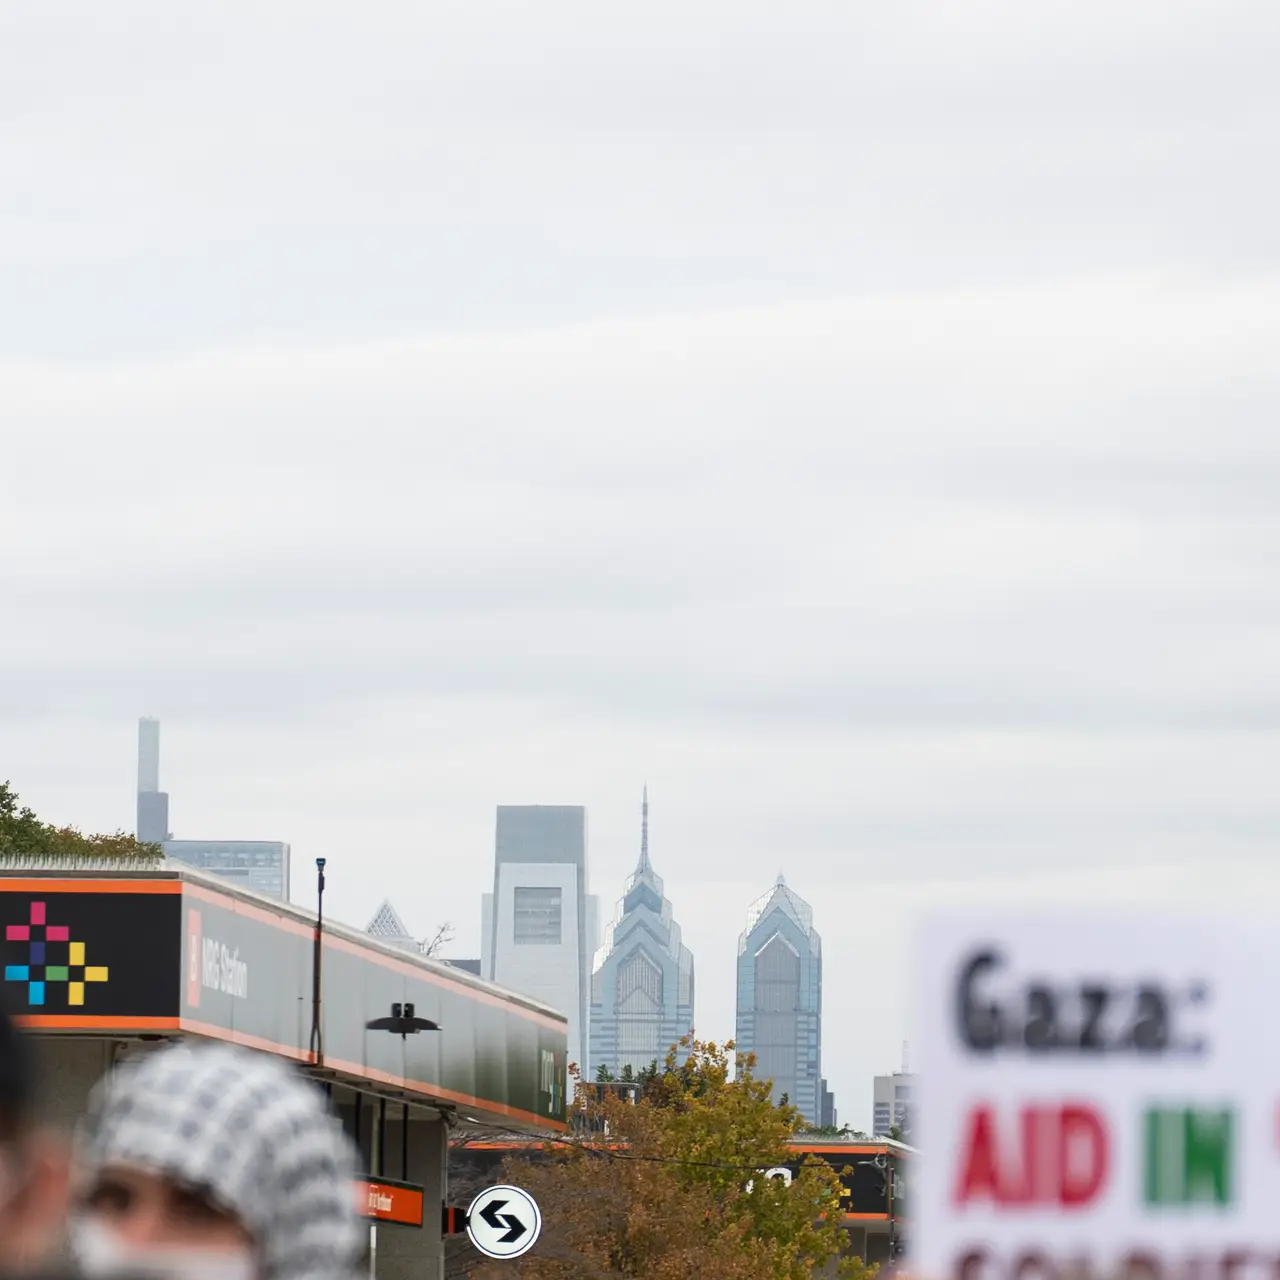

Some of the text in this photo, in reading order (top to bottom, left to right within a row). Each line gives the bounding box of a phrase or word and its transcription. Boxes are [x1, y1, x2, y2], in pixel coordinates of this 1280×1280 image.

[203, 937, 220, 990] NRG
[954, 944, 1210, 1055] Gaza:
[953, 1098, 1236, 1210] AID IN
